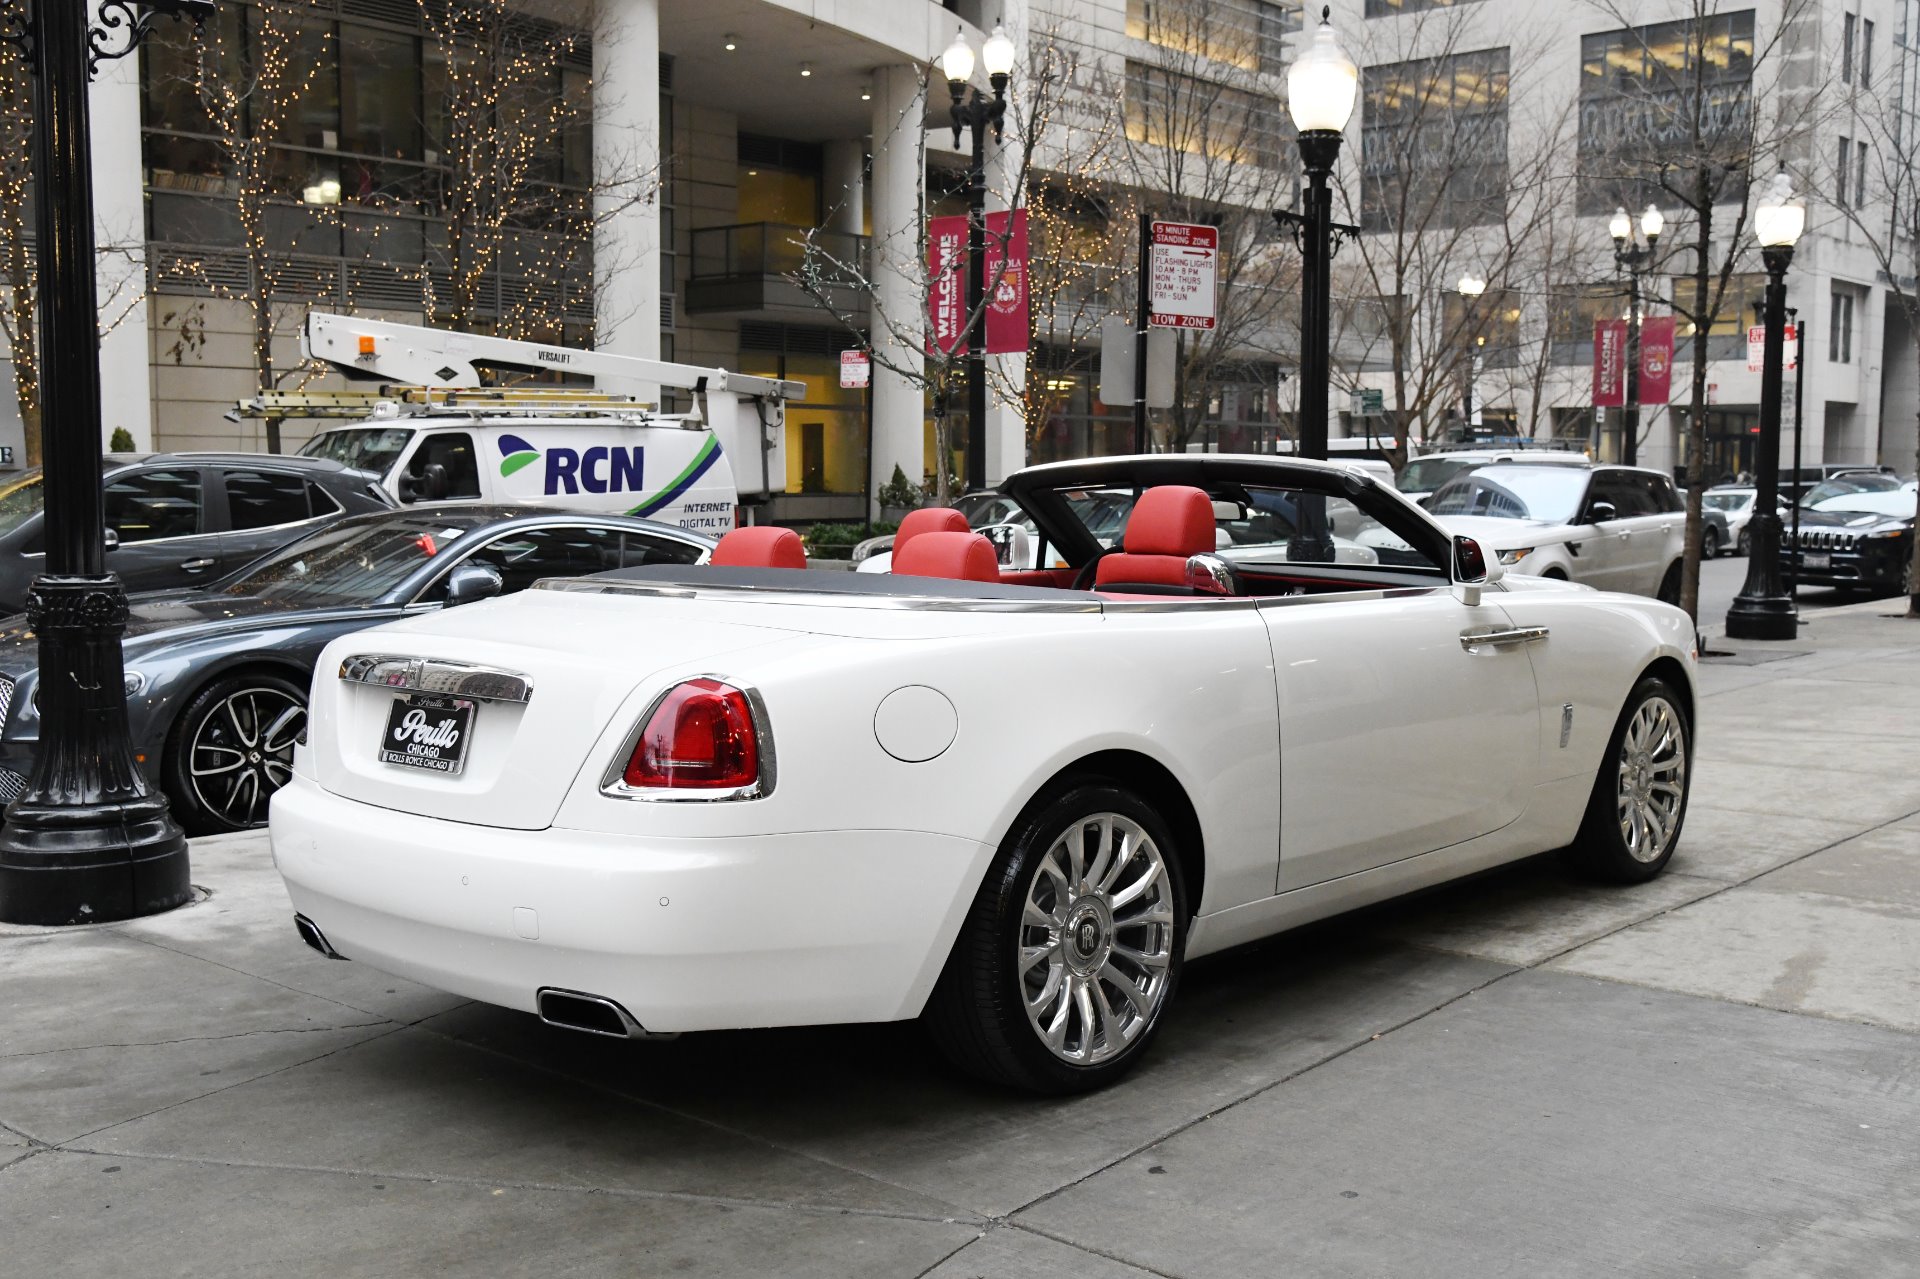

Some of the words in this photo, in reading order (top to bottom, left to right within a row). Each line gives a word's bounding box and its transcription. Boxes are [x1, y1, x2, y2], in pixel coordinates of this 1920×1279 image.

[1156, 224, 1164, 233] 15
[1165, 226, 1190, 236] MINUTE
[1156, 233, 1190, 245] STANDING
[1192, 237, 1210, 247] ZONE
[1155, 248, 1170, 257] USE
[1155, 256, 1189, 267] FLASHING
[1190, 260, 1213, 269] LIGHTS
[1164, 266, 1175, 274] AM
[1188, 267, 1199, 275] PM
[938, 234, 951, 338] WELCOME
[1154, 274, 1170, 282] MON
[1178, 275, 1201, 286] THURS
[1163, 283, 1174, 291] AM
[1187, 285, 1197, 293] PM
[1154, 291, 1167, 299] FRI
[1172, 292, 1188, 301] SUN
[1154, 314, 1177, 325] TOW
[1181, 316, 1209, 328] ZONE
[538, 350, 571, 364] VERSALIFT
[1600, 330, 1613, 394] WELCOME
[544, 446, 644, 495] RCN
[684, 502, 732, 513] INTERNET
[679, 518, 716, 529] DIGITAL
[718, 517, 731, 527] TV
[393, 709, 460, 748] Perillo
[407, 743, 440, 758] CHICAGO
[388, 753, 405, 763] ROLLS
[405, 755, 424, 767] ROYCE
[424, 758, 448, 770] CHICAGO
